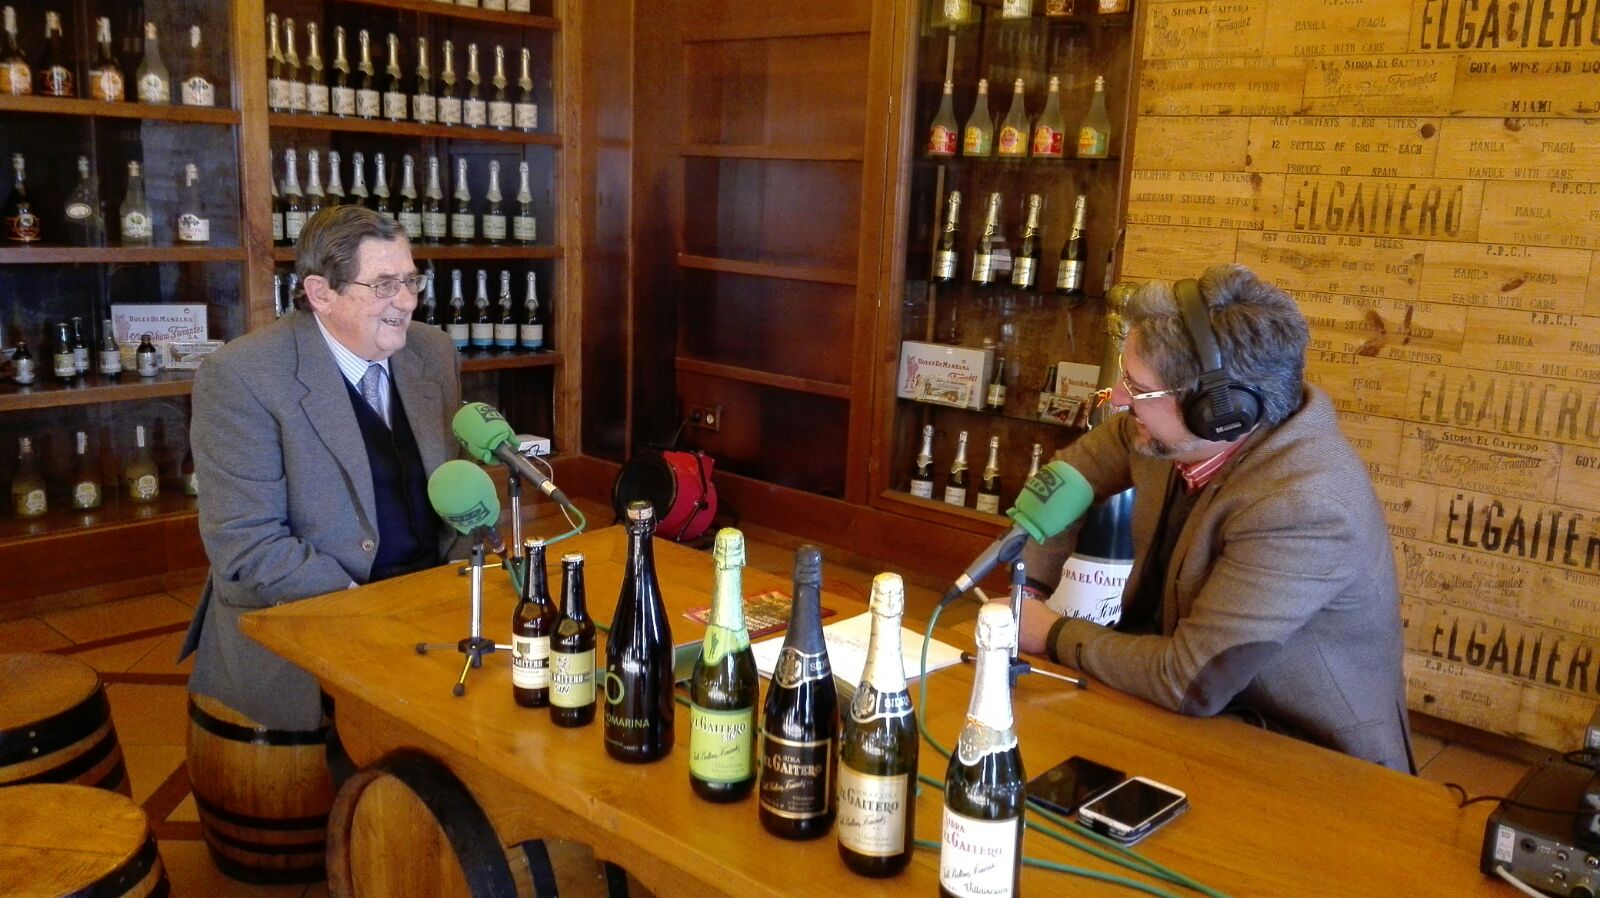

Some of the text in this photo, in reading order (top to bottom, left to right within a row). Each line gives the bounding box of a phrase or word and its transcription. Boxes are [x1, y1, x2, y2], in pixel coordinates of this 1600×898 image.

[1334, 43, 1355, 54] WITH
[1362, 43, 1385, 53] CARE
[1344, 60, 1374, 71] SIDRA
[1376, 59, 1388, 69] EL
[1470, 62, 1497, 73] GOYA
[1510, 62, 1540, 73] WINE
[1271, 139, 1280, 149] 12
[1291, 141, 1325, 151] BOTTLES
[1335, 142, 1345, 151] OF
[1355, 142, 1370, 153] 680
[1399, 144, 1423, 154] EACH
[1470, 141, 1576, 154] MANILA FRAGIL
[1287, 163, 1322, 175] PRODUCE
[1371, 166, 1397, 177] SPAIN
[1469, 167, 1574, 180] HANDLE WITH CARE
[1286, 234, 1327, 245] CONTENTS
[1359, 285, 1385, 296] SPAIN
[1442, 430, 1473, 445] SIDRA
[1476, 434, 1489, 446] EL
[1078, 572, 1092, 584] EL
[700, 715, 746, 736] GAITERO
[772, 754, 823, 778] GAITERO
[847, 787, 899, 815] GAITERO
[951, 831, 1002, 858] GAITERO
